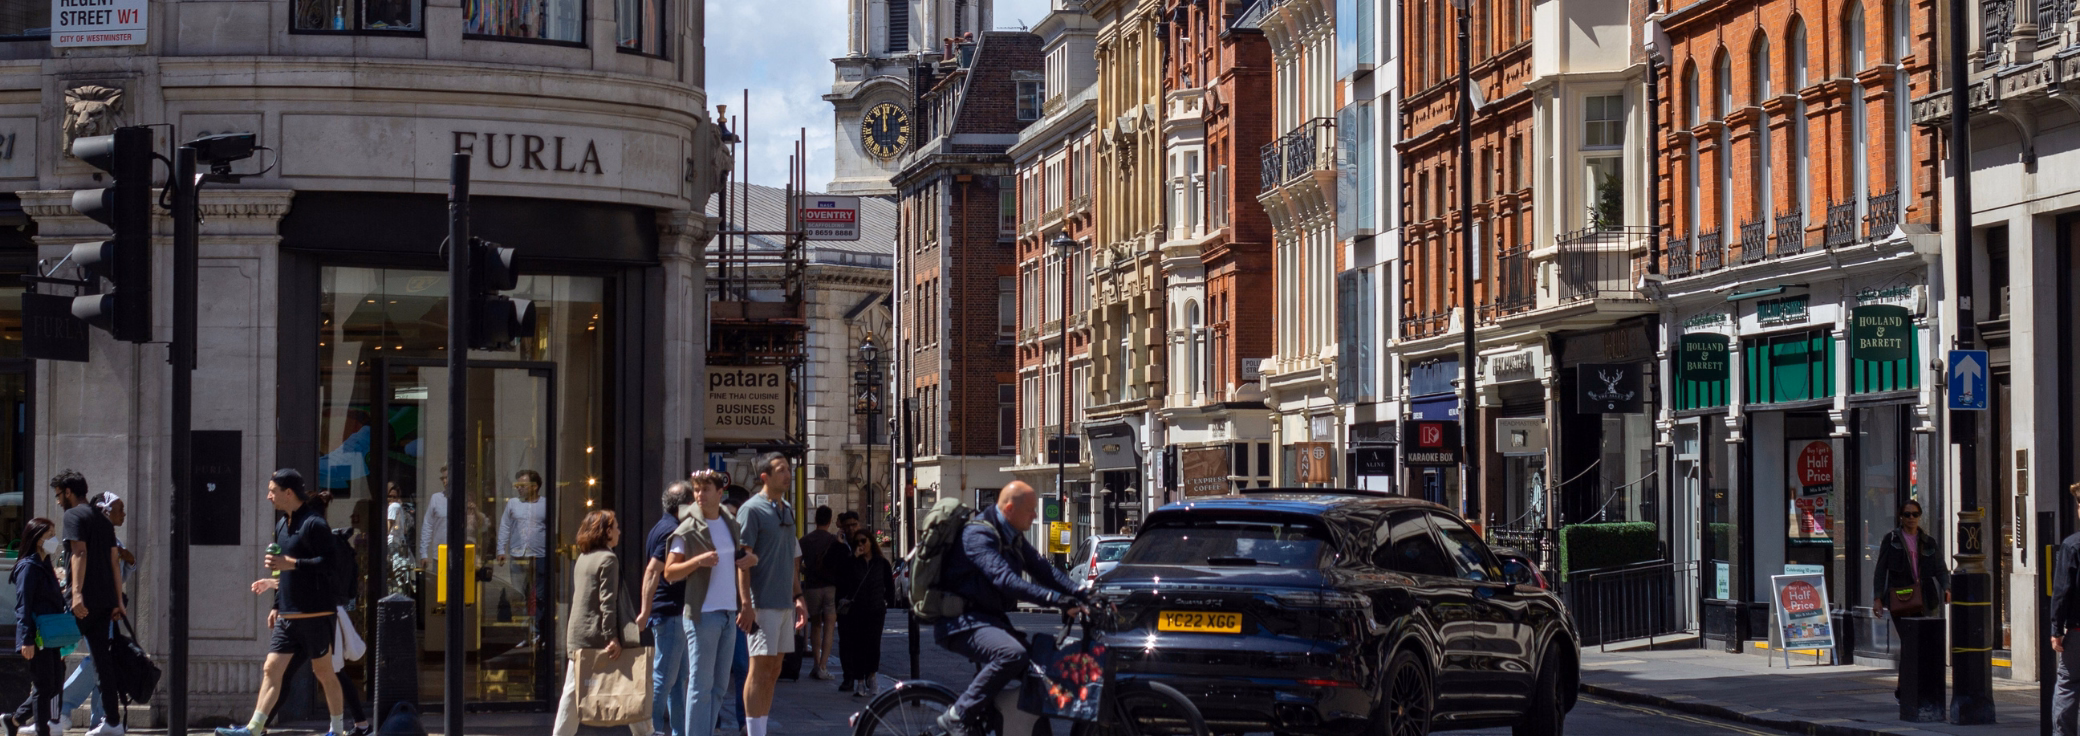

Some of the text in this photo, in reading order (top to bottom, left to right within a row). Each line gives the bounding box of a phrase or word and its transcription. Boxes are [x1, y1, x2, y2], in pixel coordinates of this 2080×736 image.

[60, 8, 138, 26] STREET W1
[86, 33, 132, 42] WESTMINSTER
[451, 131, 604, 175] FURLA
[1859, 316, 1902, 327] HOLLAND
[32, 315, 85, 340] FURLA
[1876, 326, 1885, 337] &
[1686, 342, 1724, 352] HOLLAND
[1860, 338, 1902, 349] BARRETT
[1701, 351, 1709, 361] &
[1687, 361, 1723, 371] BARRETT
[710, 369, 779, 392] patara
[716, 404, 775, 414] BUSINESS
[716, 415, 775, 425] AS USUAL
[1301, 447, 1309, 477] HANA
[1408, 453, 1454, 462] KARAOKE BOX
[1807, 455, 1829, 468] Half
[1807, 469, 1831, 482] Price
[1789, 590, 1811, 600] Half
[1791, 600, 1815, 610] Price
[1166, 613, 1236, 629] YC22 XGG
